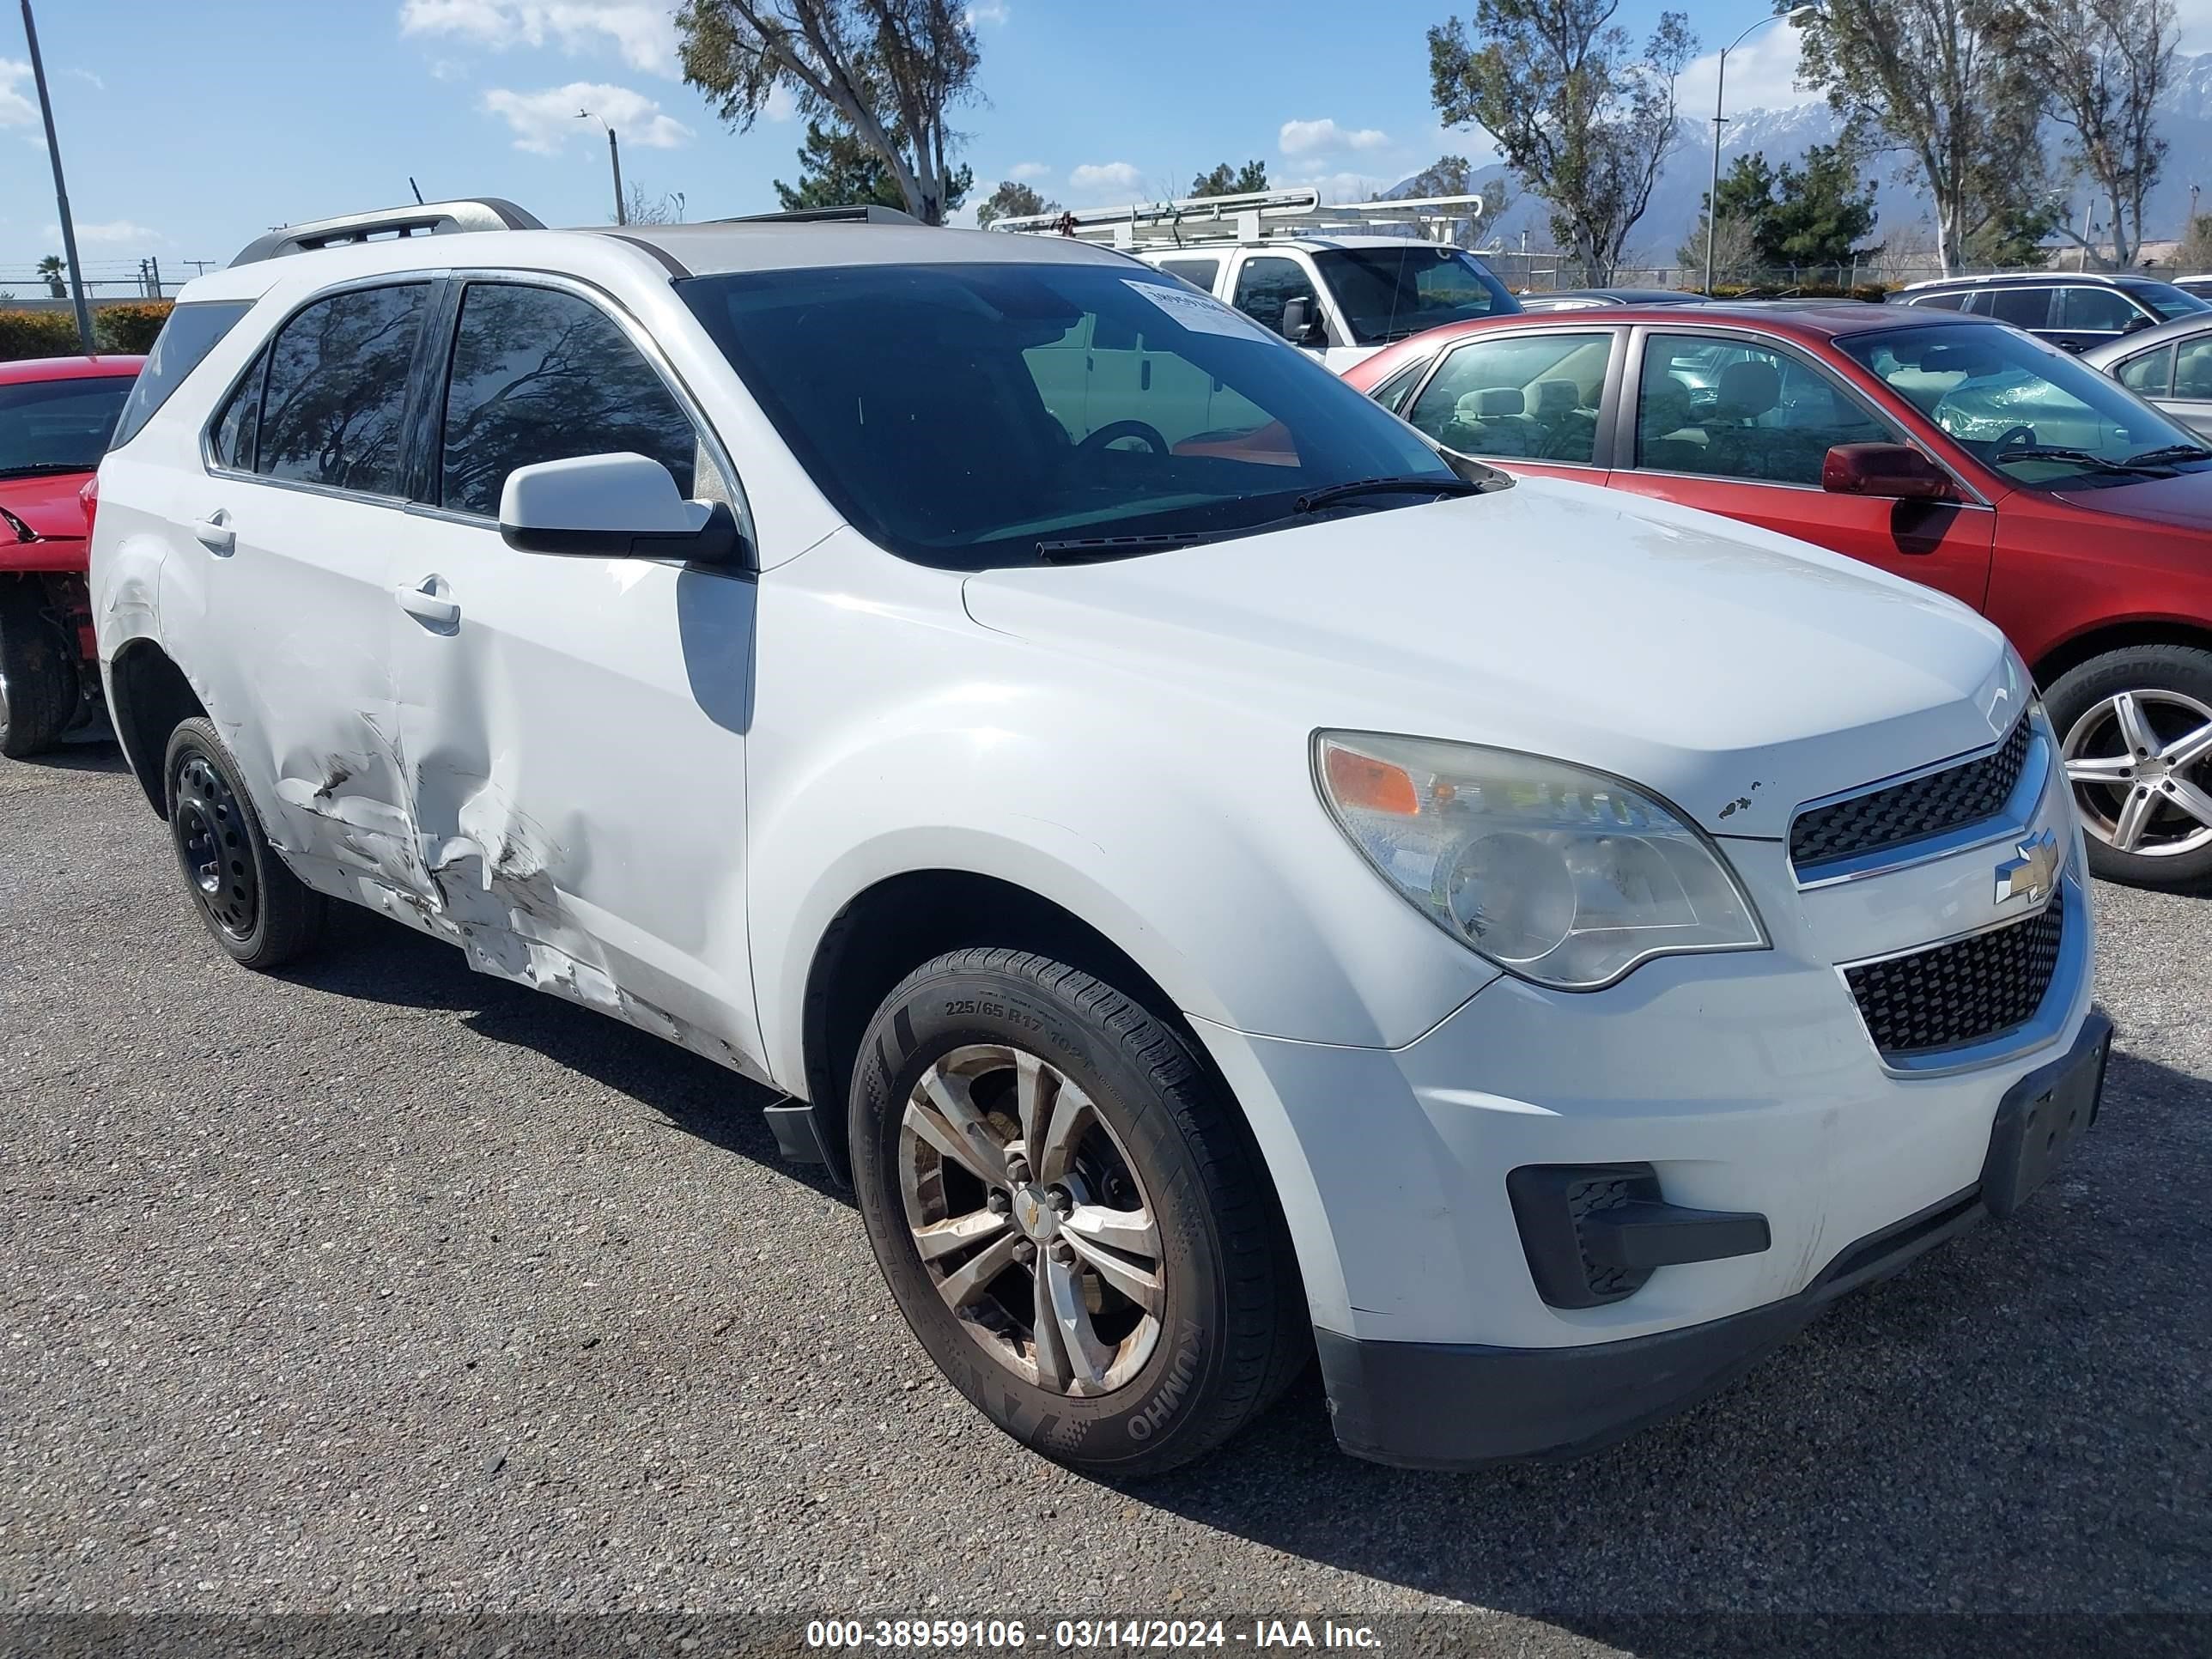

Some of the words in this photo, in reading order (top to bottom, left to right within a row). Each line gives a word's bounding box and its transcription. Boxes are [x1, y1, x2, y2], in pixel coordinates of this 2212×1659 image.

[945, 1000, 1005, 1019] 225/65
[1008, 1008, 1044, 1033] R17
[1127, 1318, 1205, 1442] KUMHO
